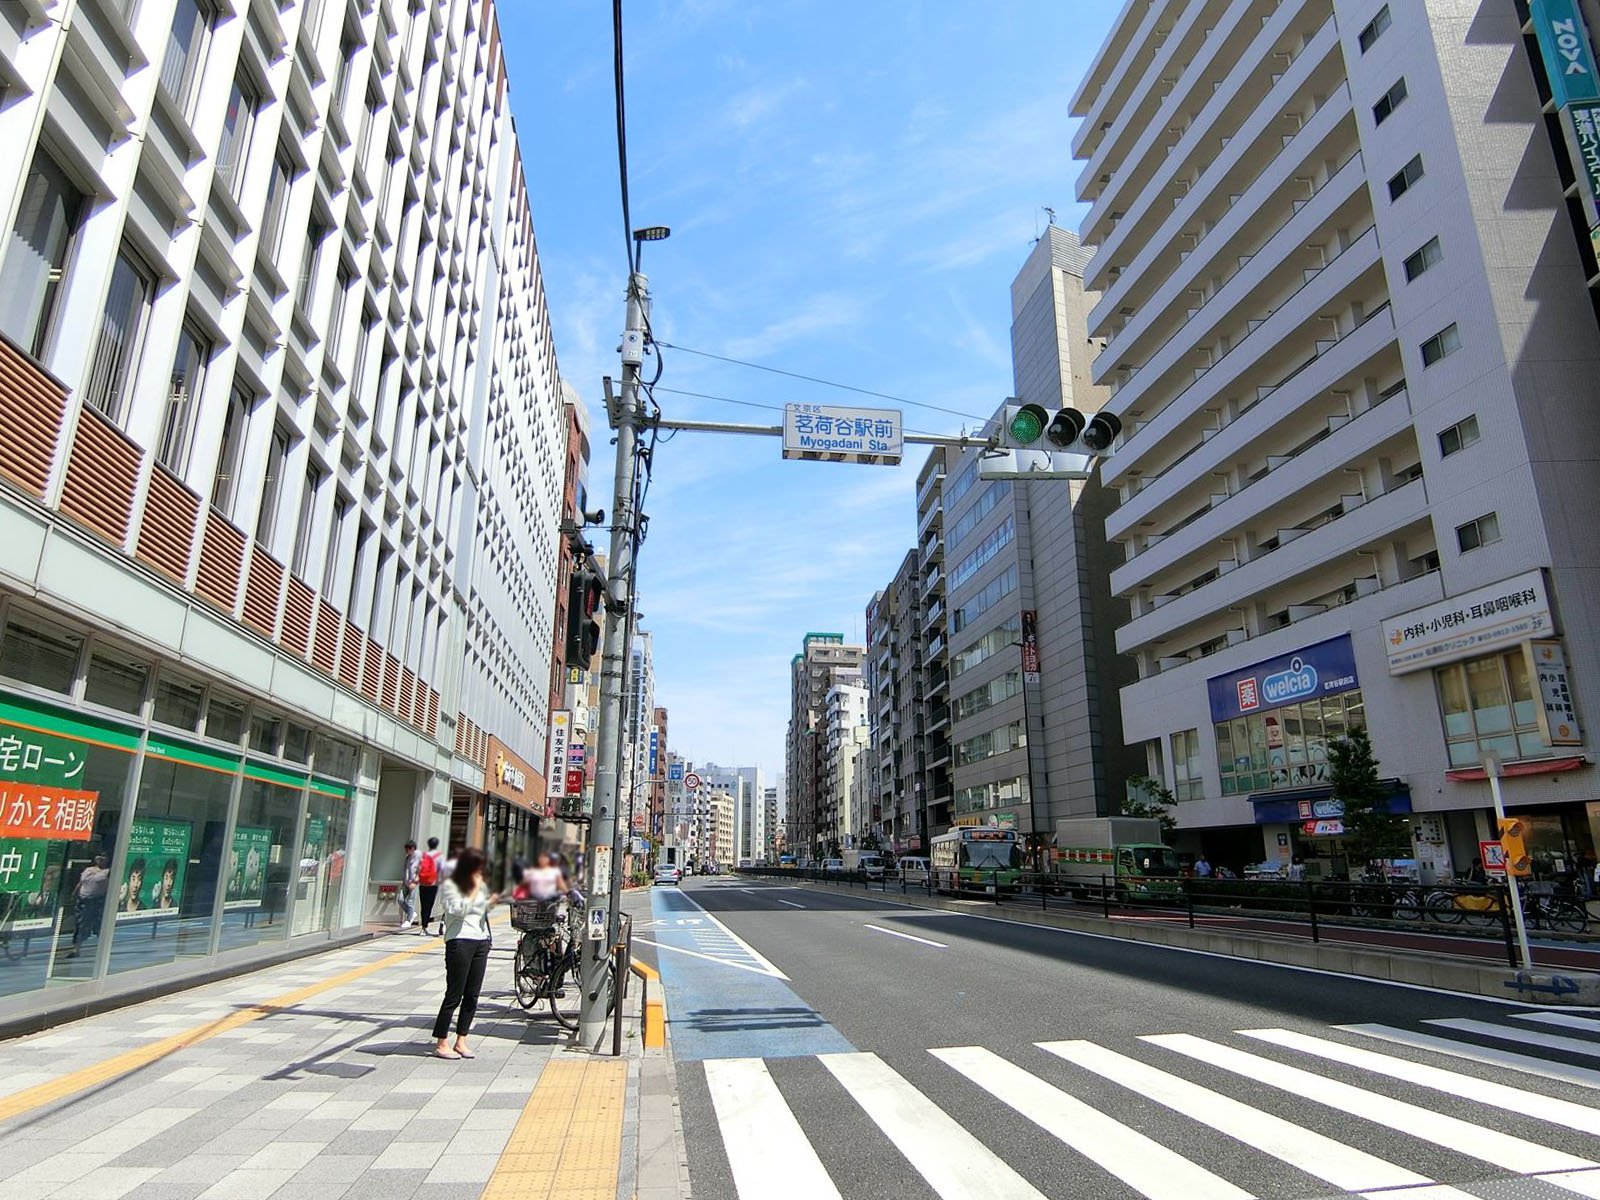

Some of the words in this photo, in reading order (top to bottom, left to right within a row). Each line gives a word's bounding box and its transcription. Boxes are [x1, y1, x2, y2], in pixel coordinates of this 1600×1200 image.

[1552, 18, 1588, 75] NOVA
[793, 404, 822, 414] 文京区
[794, 414, 894, 439] 茗荷谷駅前
[800, 435, 863, 450] Myogadani
[1240, 682, 1257, 706] 薬
[1265, 671, 1312, 698] welcia
[0, 734, 85, 779] 宅ローン
[551, 728, 565, 793] 住友不動産販売
[0, 846, 39, 885] 中!
